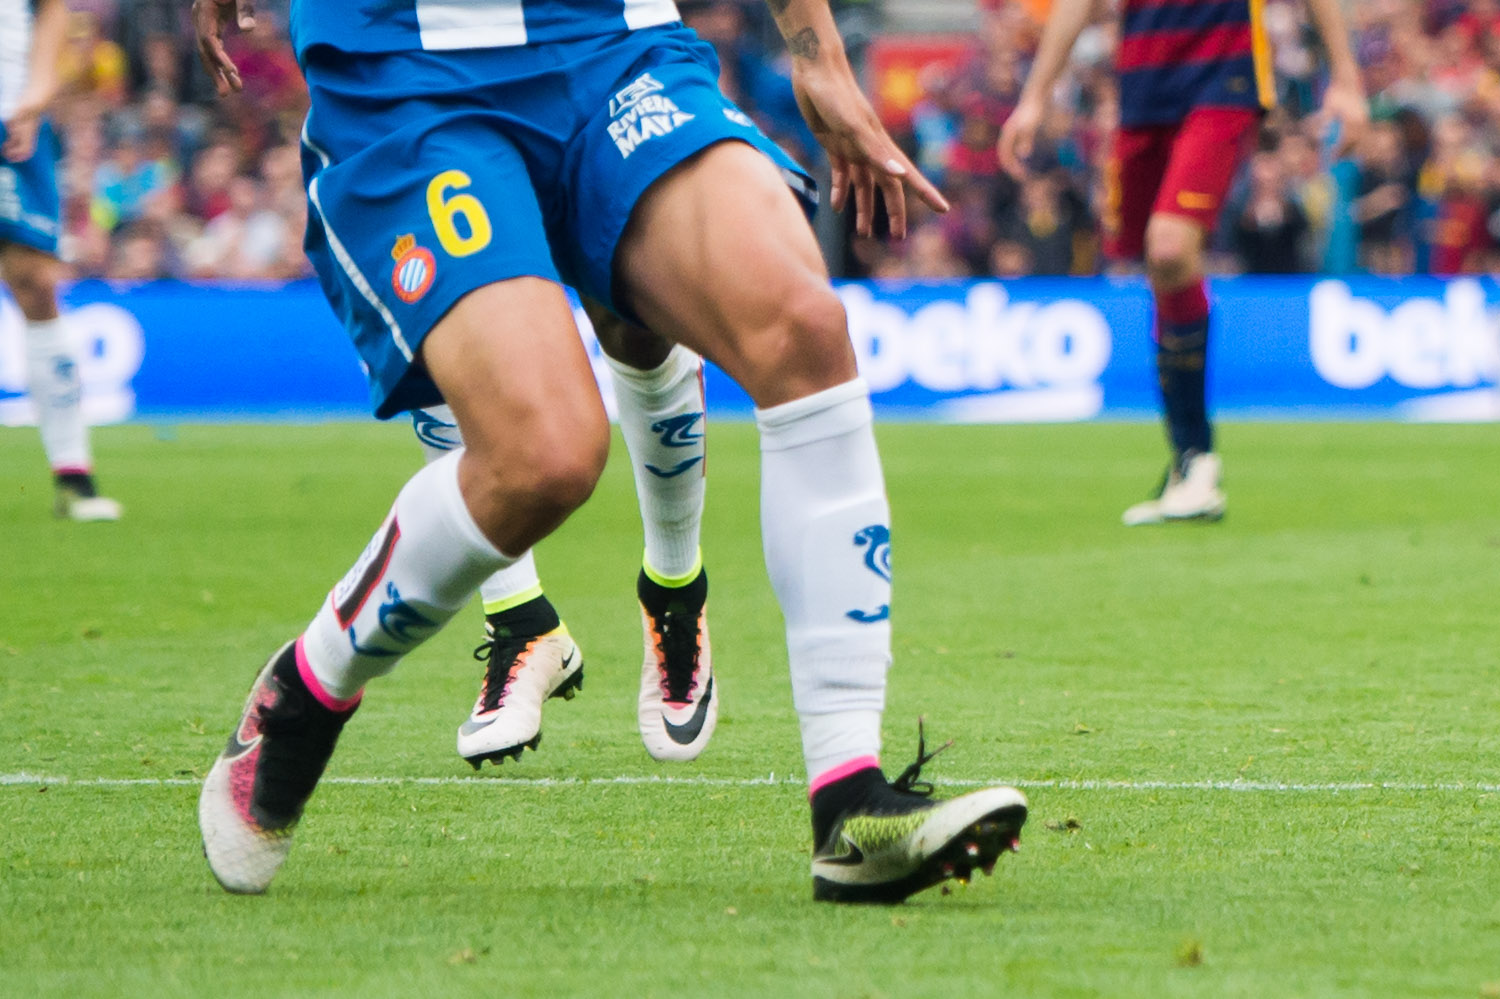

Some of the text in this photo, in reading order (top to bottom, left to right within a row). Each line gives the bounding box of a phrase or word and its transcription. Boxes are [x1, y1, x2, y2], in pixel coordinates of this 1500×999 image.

[615, 111, 695, 160] MAYA
[426, 169, 493, 258] 6
[835, 282, 1113, 392] beko
